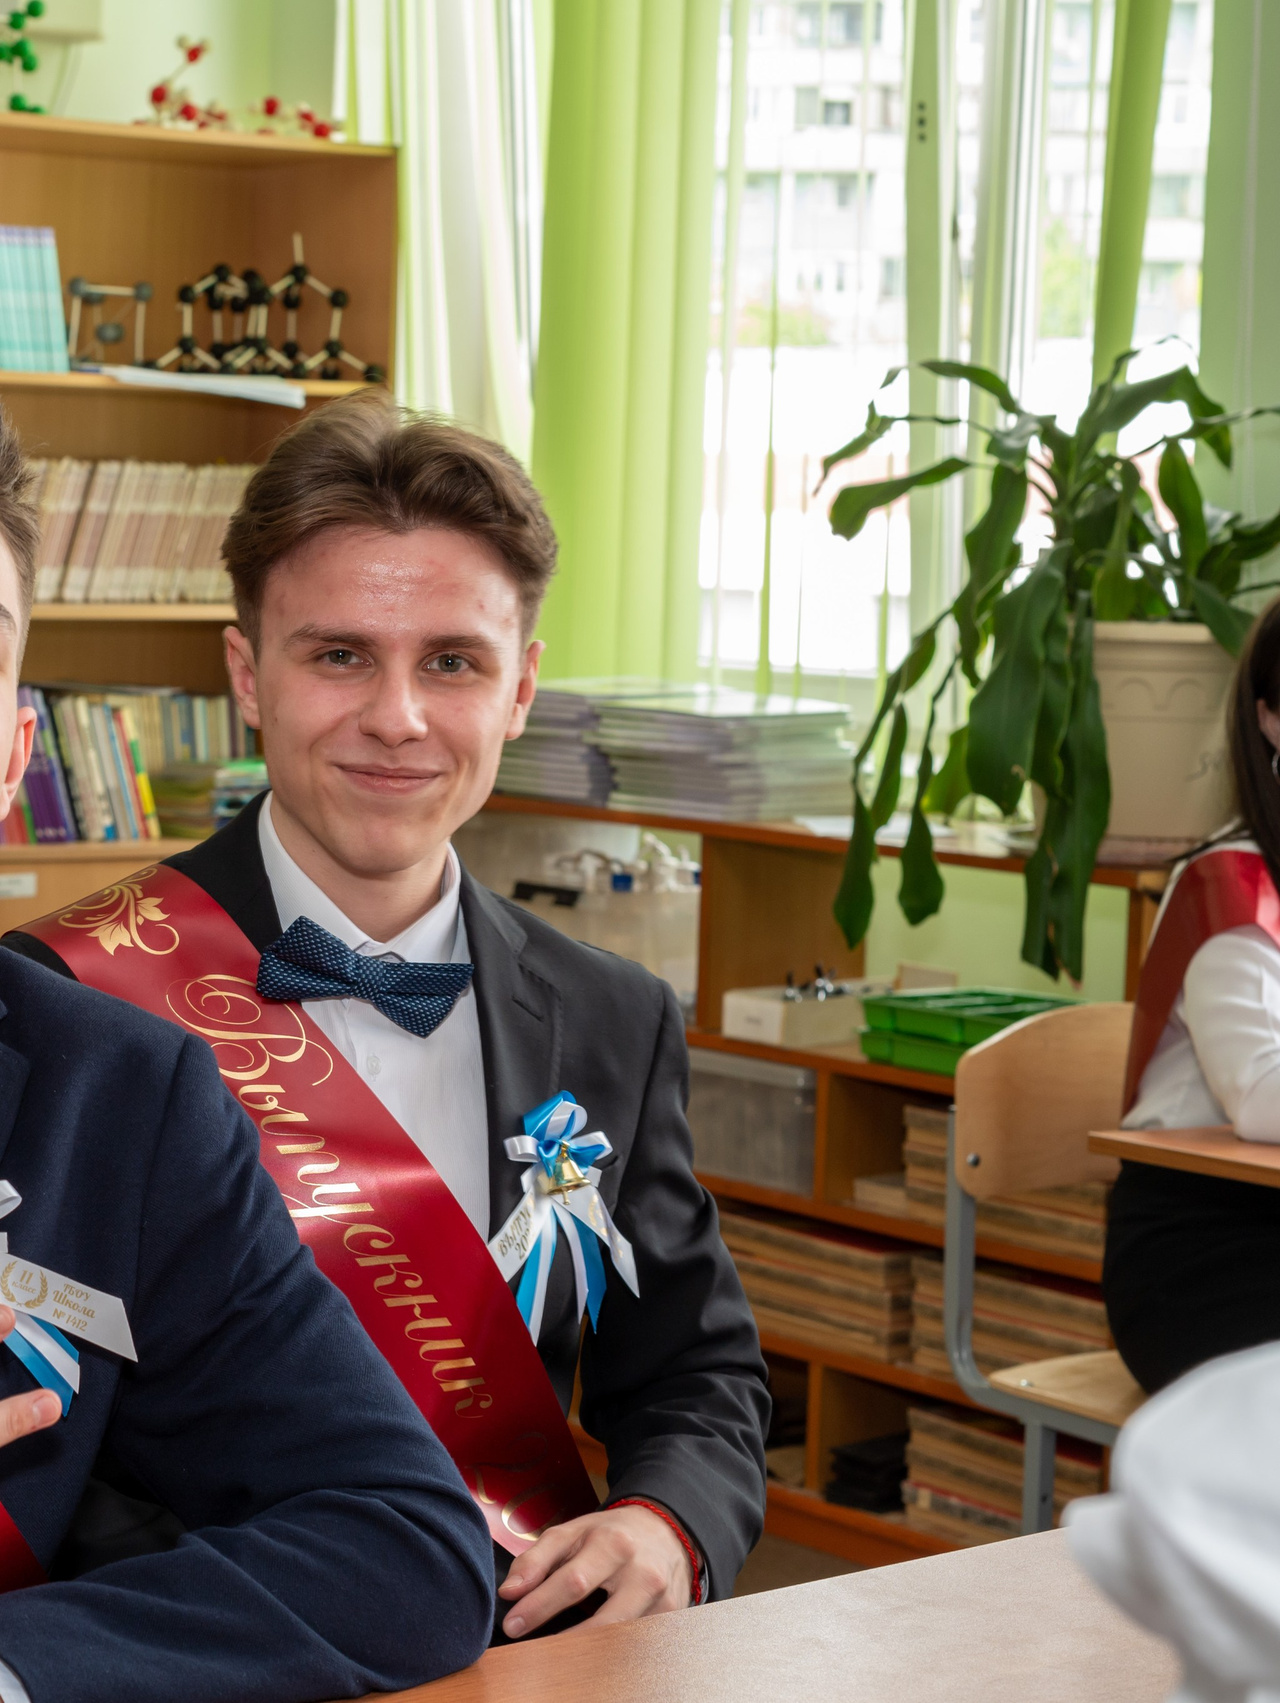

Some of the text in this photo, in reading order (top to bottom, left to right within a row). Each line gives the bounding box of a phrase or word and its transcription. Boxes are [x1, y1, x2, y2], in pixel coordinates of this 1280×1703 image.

[166, 974, 493, 1419] Выпускник
[20, 1269, 34, 1285] 11
[52, 1289, 96, 1319] Школа
[63, 1283, 91, 1302] ГБОУ
[65, 1314, 88, 1332] 1412
[464, 1431, 568, 1541] 20
